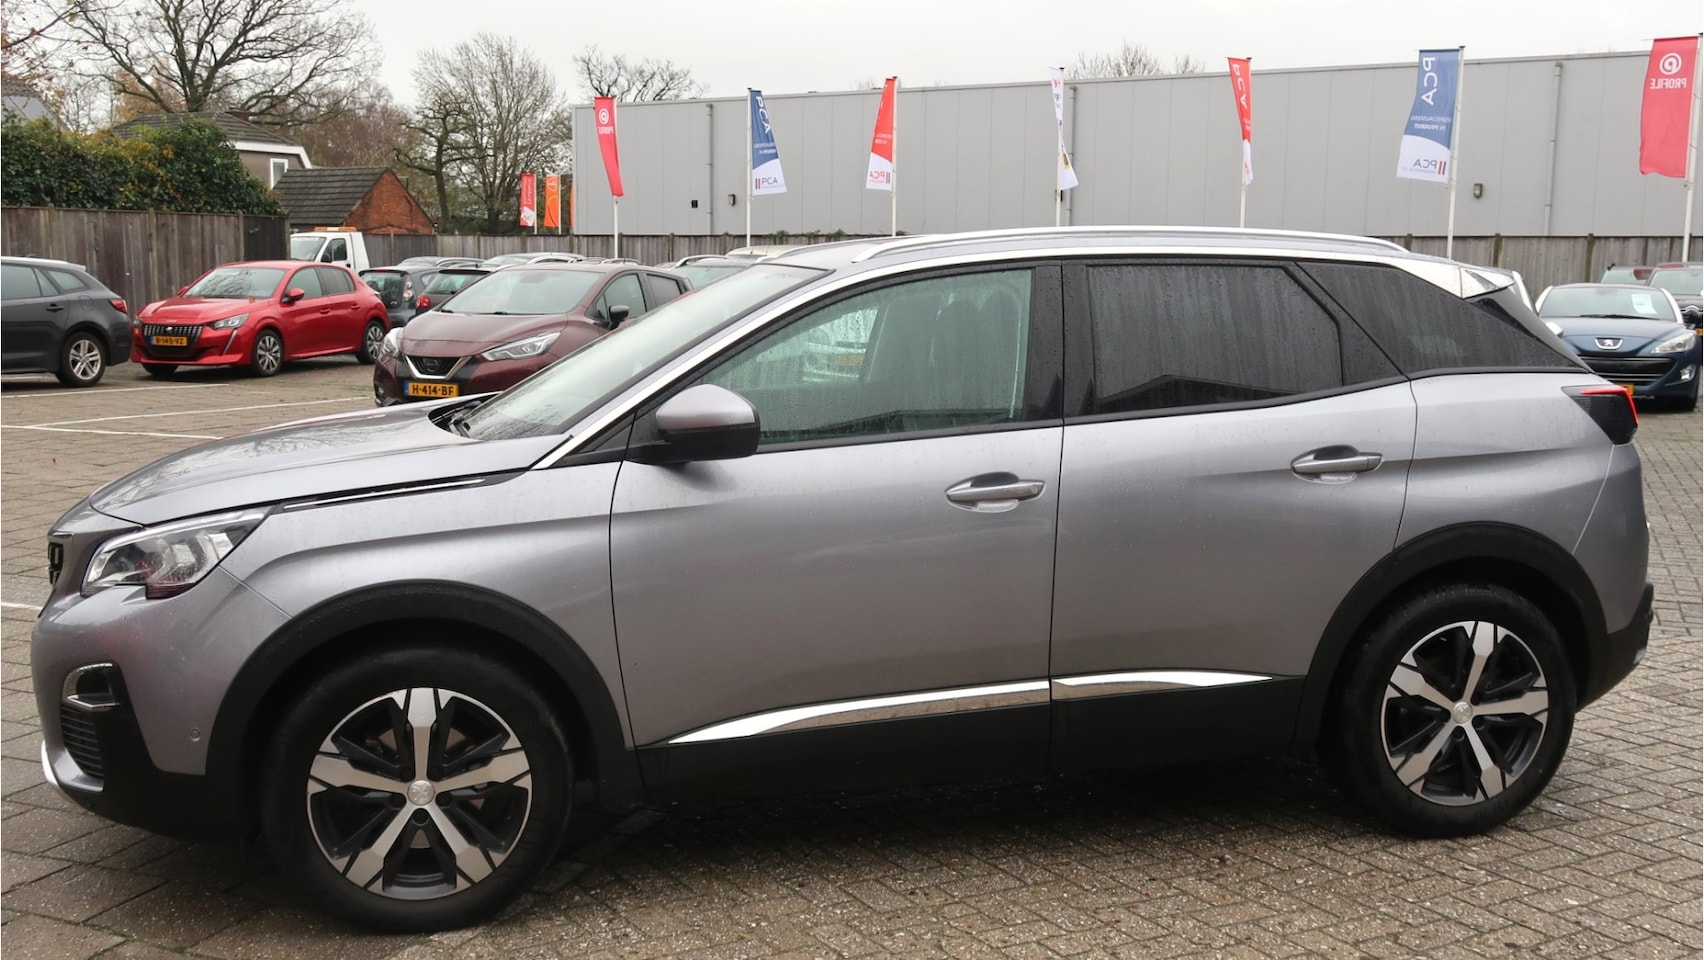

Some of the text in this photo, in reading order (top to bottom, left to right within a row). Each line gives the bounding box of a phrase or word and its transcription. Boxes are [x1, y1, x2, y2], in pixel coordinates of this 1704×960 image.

[755, 95, 771, 134] PCA
[761, 176, 779, 185] PCA
[412, 384, 454, 396] H-414-BF
